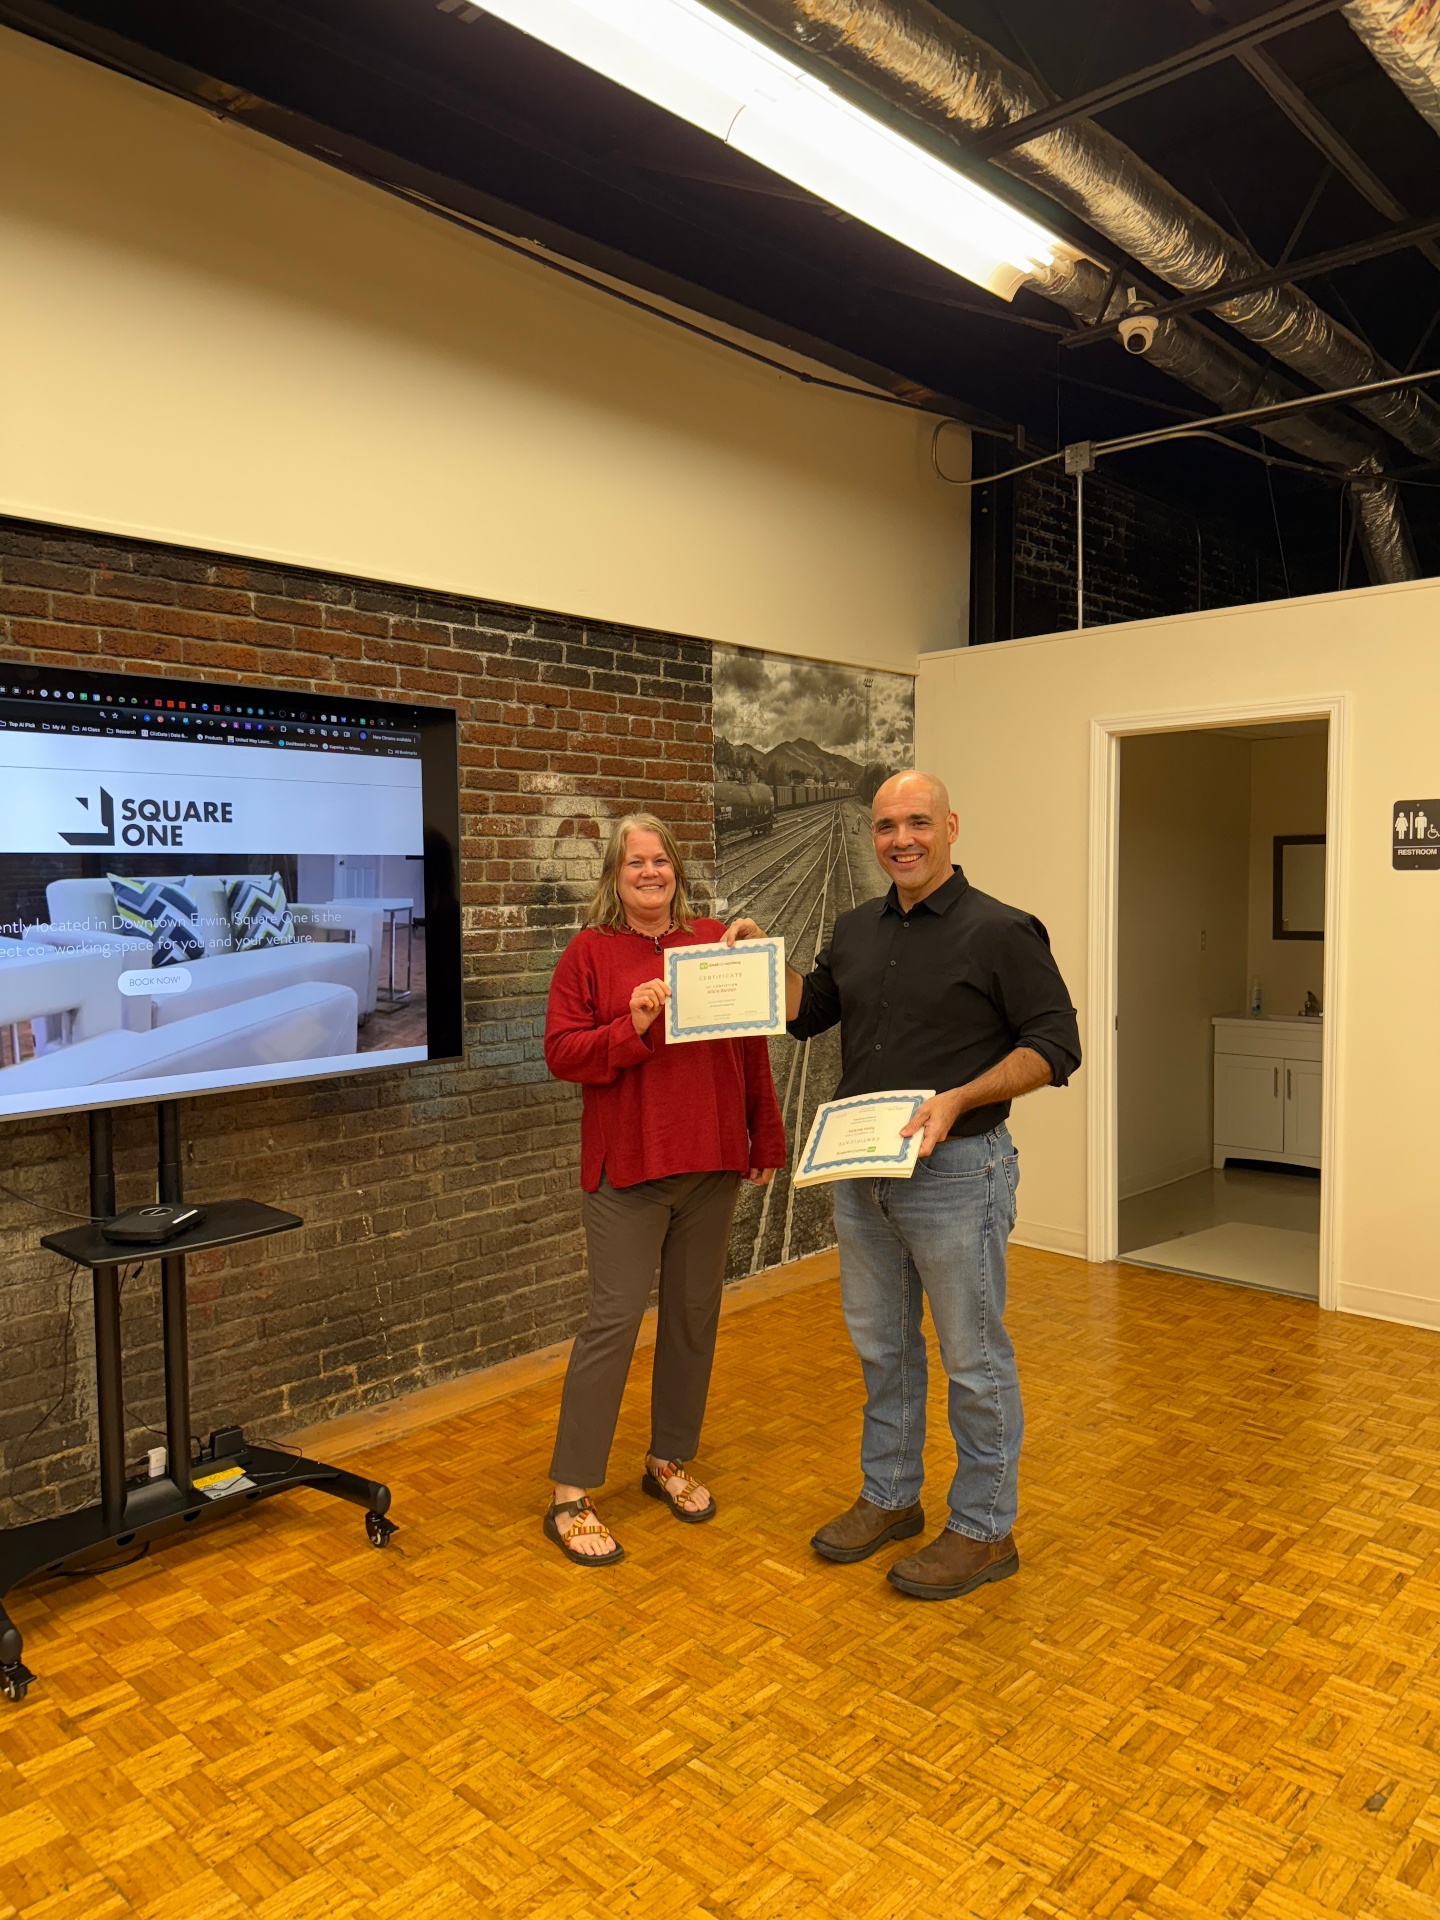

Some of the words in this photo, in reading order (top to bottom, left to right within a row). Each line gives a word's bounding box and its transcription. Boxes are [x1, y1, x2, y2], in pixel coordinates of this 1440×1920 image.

[122, 798, 232, 823] SQUARE
[122, 824, 183, 846] ONE
[0, 918, 31, 938] ently
[36, 917, 90, 933] located
[95, 916, 106, 930] in
[112, 915, 186, 930] Downtown
[191, 912, 230, 928] Erwin,
[234, 912, 278, 930] Square
[282, 911, 308, 924] One
[312, 911, 320, 923] is
[323, 910, 342, 923] the
[0, 946, 22, 958] ect
[115, 940, 154, 956] space
[158, 936, 177, 950] for
[182, 940, 204, 953] you
[208, 934, 232, 948] and
[236, 938, 263, 952] your
[267, 934, 315, 944] venture.
[130, 978, 154, 986] BOOK
[699, 972, 743, 981] CERTIFICATE
[838, 1137, 880, 1146] CERTIFICATE
